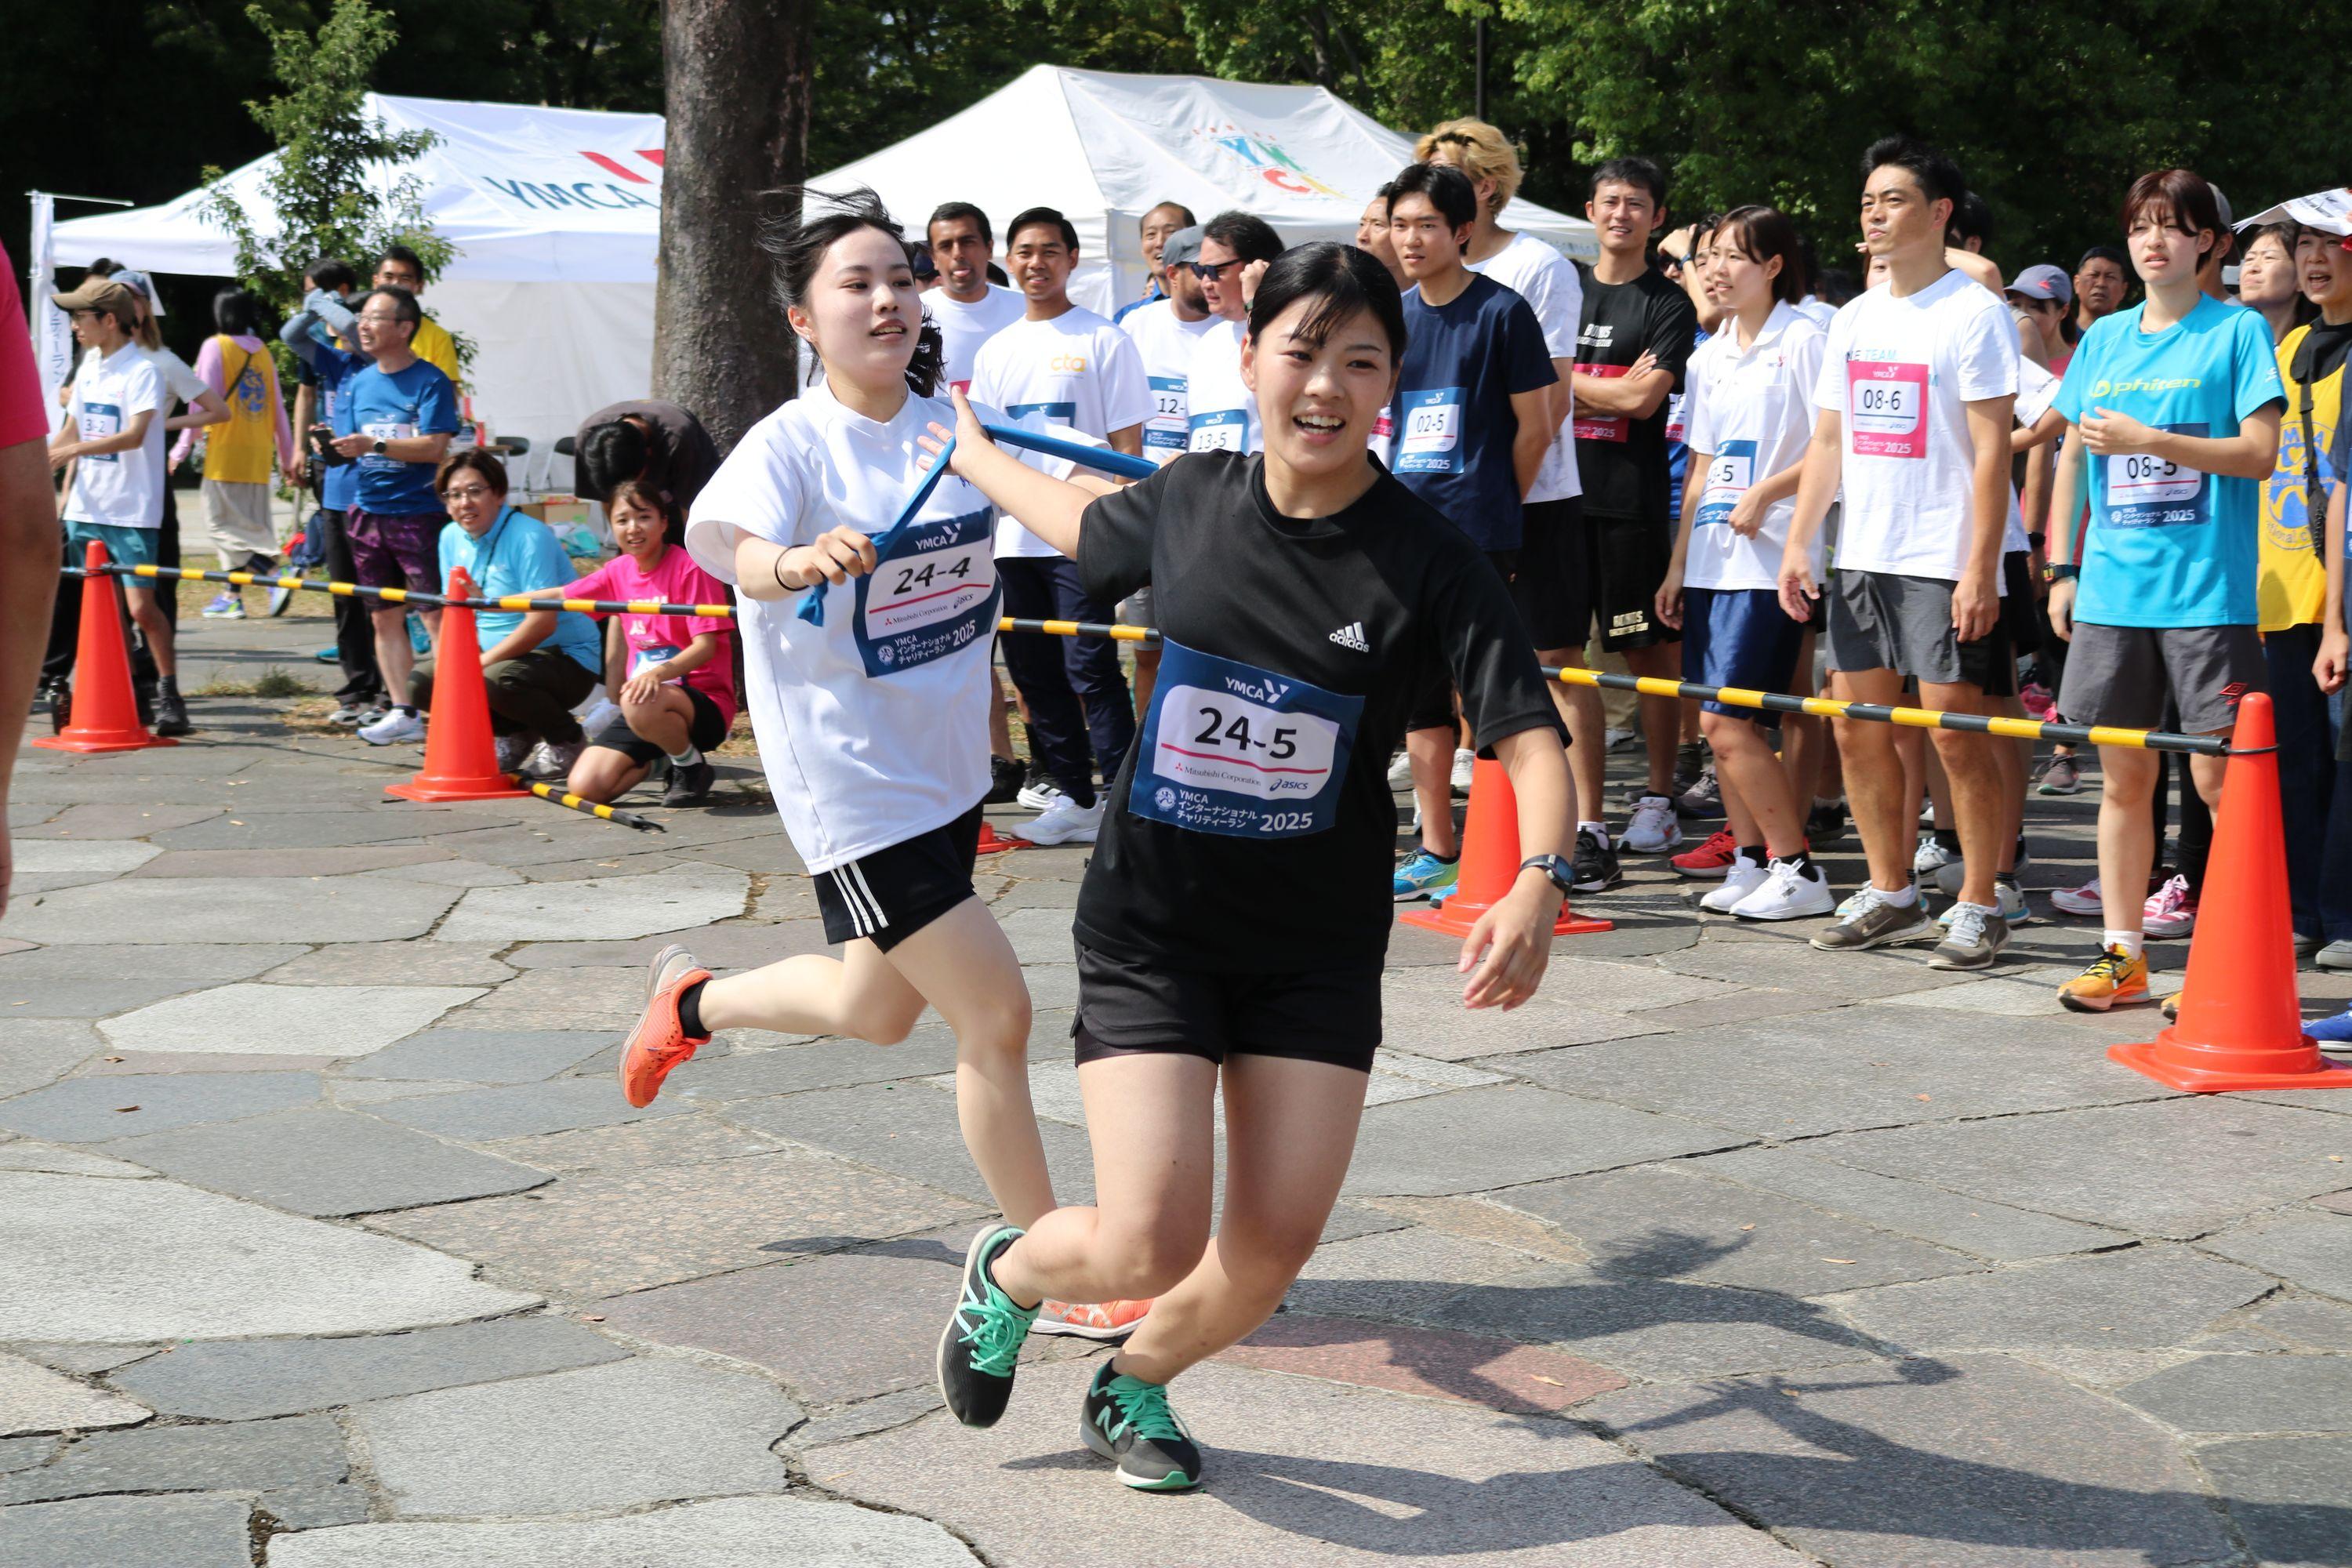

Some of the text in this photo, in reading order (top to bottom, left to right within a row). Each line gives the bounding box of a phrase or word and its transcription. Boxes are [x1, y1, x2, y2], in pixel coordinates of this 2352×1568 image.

[481, 176, 662, 210] YMCA
[49, 306, 65, 383] ティーラン
[1051, 353, 1087, 372] cta
[2112, 377, 2201, 397] phiten
[1158, 397, 1186, 414] 12-
[1864, 388, 1901, 411] 08-6
[1417, 413, 1444, 433] 02-5
[1197, 432, 1227, 450] 13-5
[1883, 441, 1912, 454] 2025
[1426, 459, 1451, 470] 2025
[2127, 456, 2178, 479] 08-5
[2162, 509, 2196, 523] 2025
[916, 536, 948, 550] YMCA
[893, 557, 971, 596] 24-4
[893, 604, 948, 625] Mitsubishi Corporation
[895, 634, 918, 647] YMCA
[952, 619, 976, 647] 2025
[1329, 632, 1370, 653] adidas
[897, 633, 952, 655] インターナショナル
[898, 644, 946, 665] チャリティーラン
[1225, 677, 1265, 701] YMCA
[1194, 706, 1297, 759] 24-5
[1185, 766, 1261, 786] Mitsubishi Corporation
[1179, 789, 1209, 804] YMCA
[1177, 810, 1247, 829] チャリティーラン
[1178, 800, 1258, 820] インターナショナル
[1259, 812, 1313, 832] 2025
